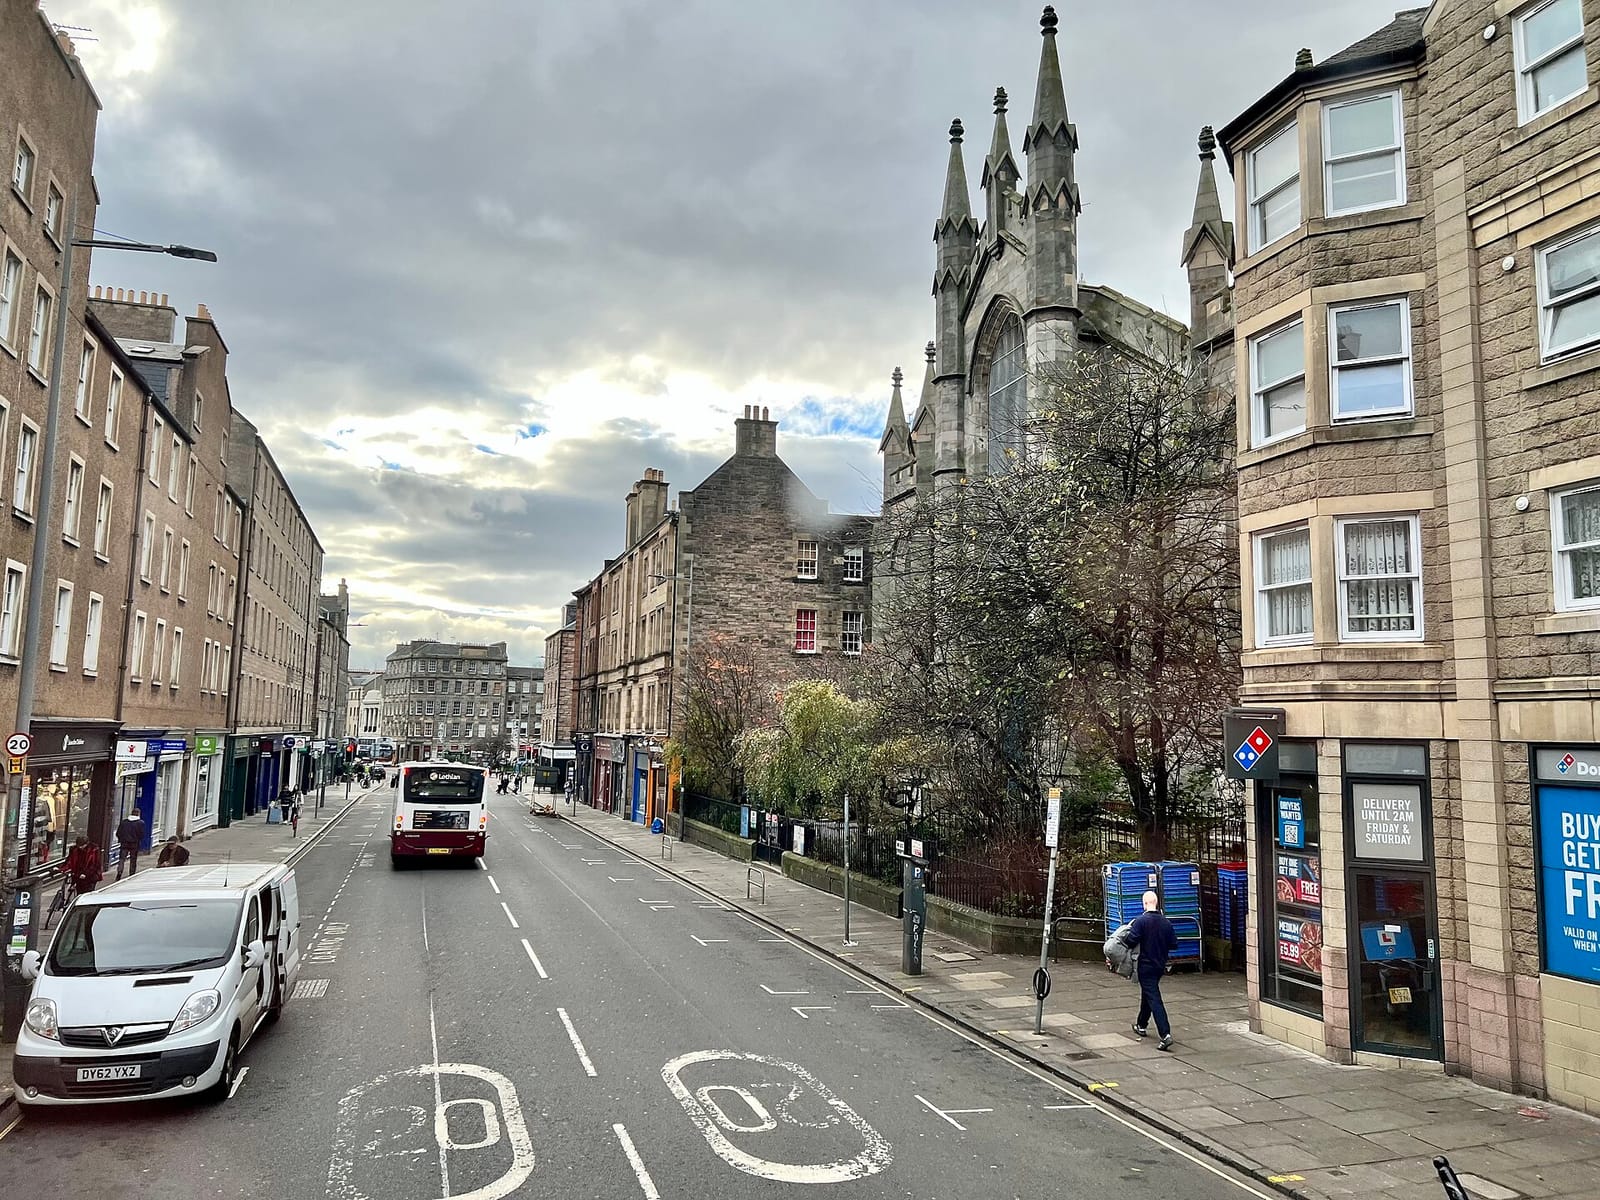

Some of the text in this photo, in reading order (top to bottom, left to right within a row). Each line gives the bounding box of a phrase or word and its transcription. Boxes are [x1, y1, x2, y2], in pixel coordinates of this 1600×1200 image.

[9, 739, 28, 750] 20
[1363, 798, 1411, 811] DELIVERY
[1361, 809, 1414, 823] UNTIL 2AM
[1366, 822, 1410, 834] FRIDAY &
[1561, 811, 1600, 841] BUY
[1365, 832, 1411, 845] SATURDAY
[1562, 840, 1600, 870] GET
[1278, 856, 1299, 868] BUY ONE
[913, 867, 921, 878] P
[1278, 866, 1299, 878] GET ONE
[1301, 881, 1319, 896] FREE
[20, 891, 31, 906] P
[1279, 921, 1299, 934] MEDIUM
[1563, 926, 1599, 942] VALID ON
[1381, 933, 1393, 943] L
[1281, 943, 1299, 959] £5.99
[1573, 938, 1597, 953] WHEN
[82, 1066, 136, 1080] DY62 YXZ
